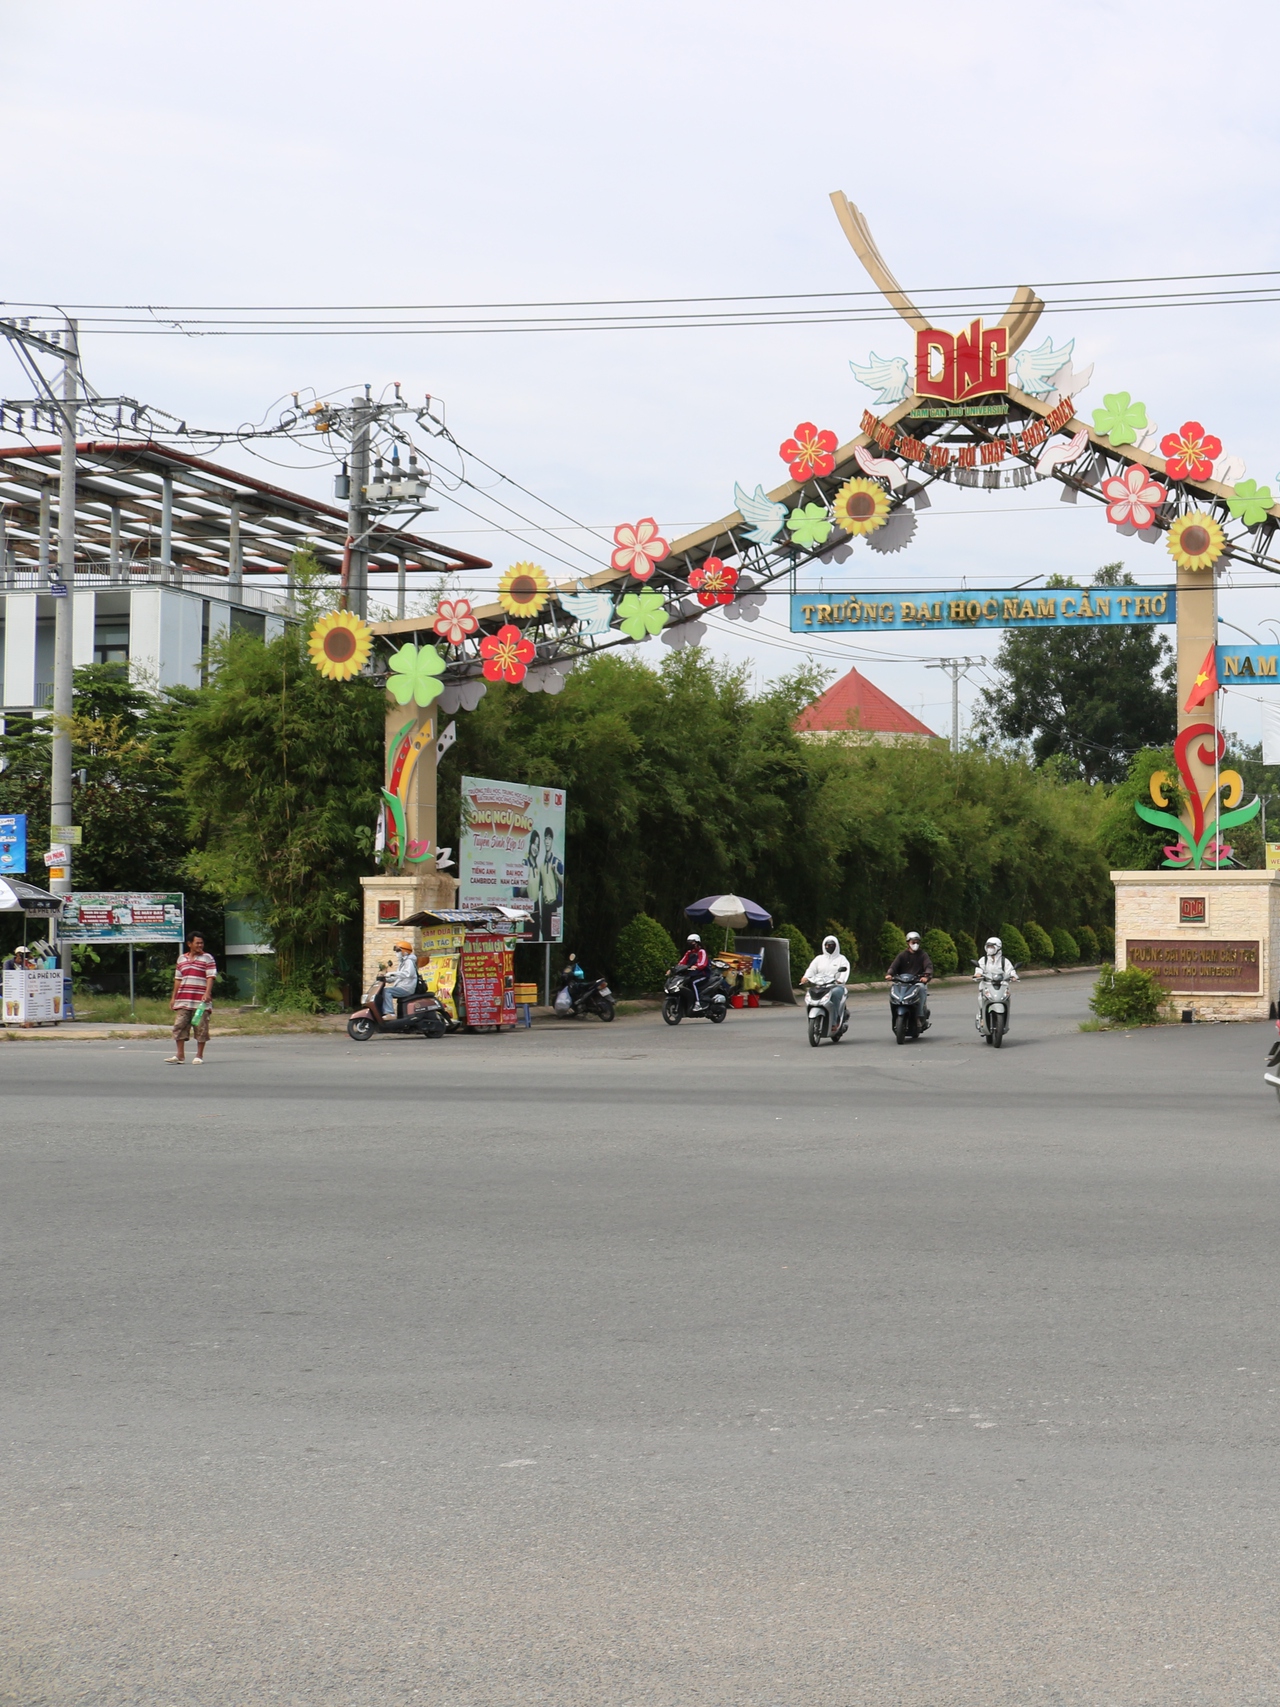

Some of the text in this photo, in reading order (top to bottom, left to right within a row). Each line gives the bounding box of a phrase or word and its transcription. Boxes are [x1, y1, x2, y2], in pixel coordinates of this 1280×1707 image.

[914, 317, 1009, 404] DNC
[910, 404, 1009, 418] NAM CAN THO UNIVERSITY
[958, 442, 976, 471] HỘI
[1011, 435, 1019, 456] &
[801, 596, 895, 625] TRƯỜNG
[901, 602, 943, 627] ĐẠI
[949, 599, 998, 626] HỌC
[1002, 598, 1056, 619] NAM
[1116, 592, 1168, 617] THƠ
[1223, 655, 1278, 676] NAM
[469, 810, 492, 824] ONG
[514, 813, 534, 832] DNC
[470, 877, 497, 885] CAMBRIDGE
[1163, 965, 1242, 976] CAN THO UNIVERSITY
